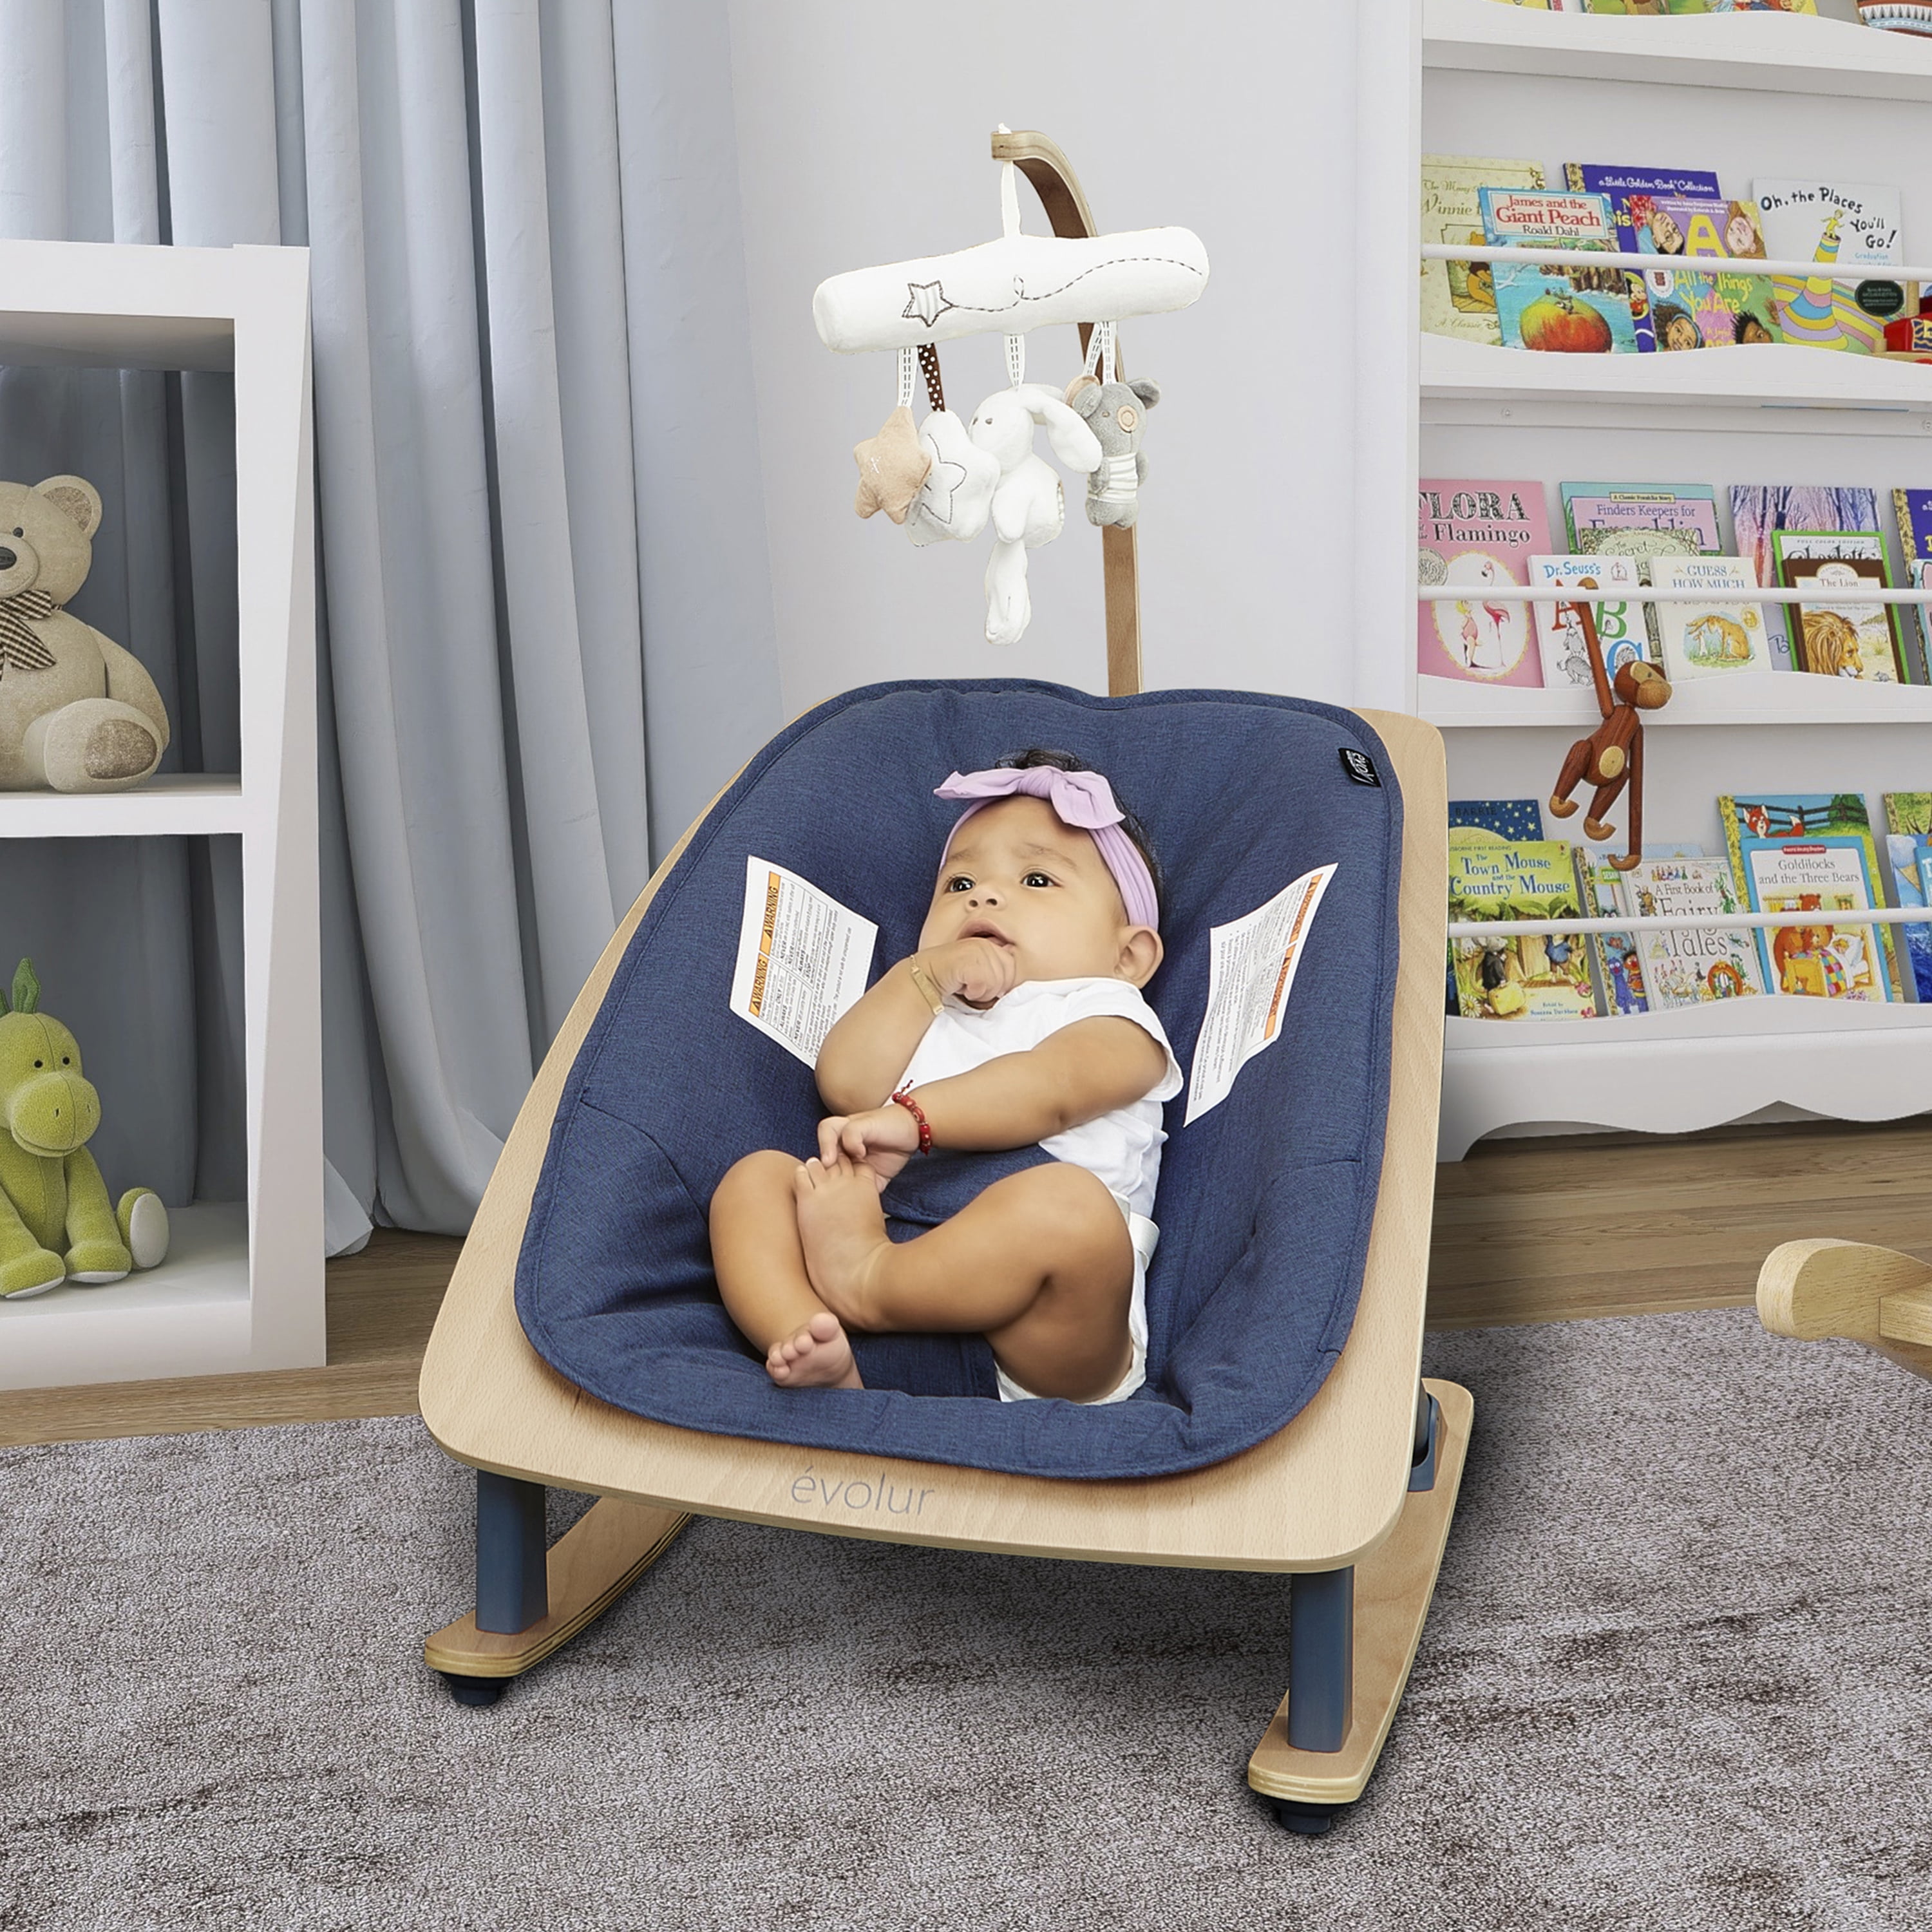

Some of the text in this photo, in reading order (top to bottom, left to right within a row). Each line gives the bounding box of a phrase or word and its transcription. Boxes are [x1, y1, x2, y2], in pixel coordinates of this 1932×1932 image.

[1627, 177, 1655, 189] Golden
[1654, 179, 1674, 190] Book
[1678, 180, 1714, 192] Collection
[1507, 195, 1587, 210] James and the
[1761, 187, 1862, 214] Oh, the Places
[1496, 207, 1546, 224] Giant
[1548, 209, 1602, 226] Peach
[1850, 217, 1884, 232] You'll
[1522, 225, 1580, 236] Roald Dahl
[1866, 229, 1897, 249] Go!
[1676, 270, 1697, 290] All
[1718, 272, 1753, 301] Things
[1680, 291, 1740, 321] You Are
[1596, 504, 1695, 518] Finders Keepers for
[1434, 523, 1530, 548] Flamingo
[1543, 562, 1601, 578] Dr. Seuss's
[1687, 565, 1727, 576] GUESS
[1672, 579, 1746, 589] HOW MUCH
[1840, 579, 1859, 587] Lion
[1461, 851, 1551, 875] Town Mouse
[1778, 859, 1835, 870] Goldilocks
[1759, 872, 1860, 884] and the Three Bears
[1450, 875, 1569, 900] Country Mouse
[1656, 882, 1714, 895] A First Book of
[764, 886, 778, 928] WARNING
[753, 959, 768, 1003] WARNING
[791, 1465, 935, 1515] évolur
